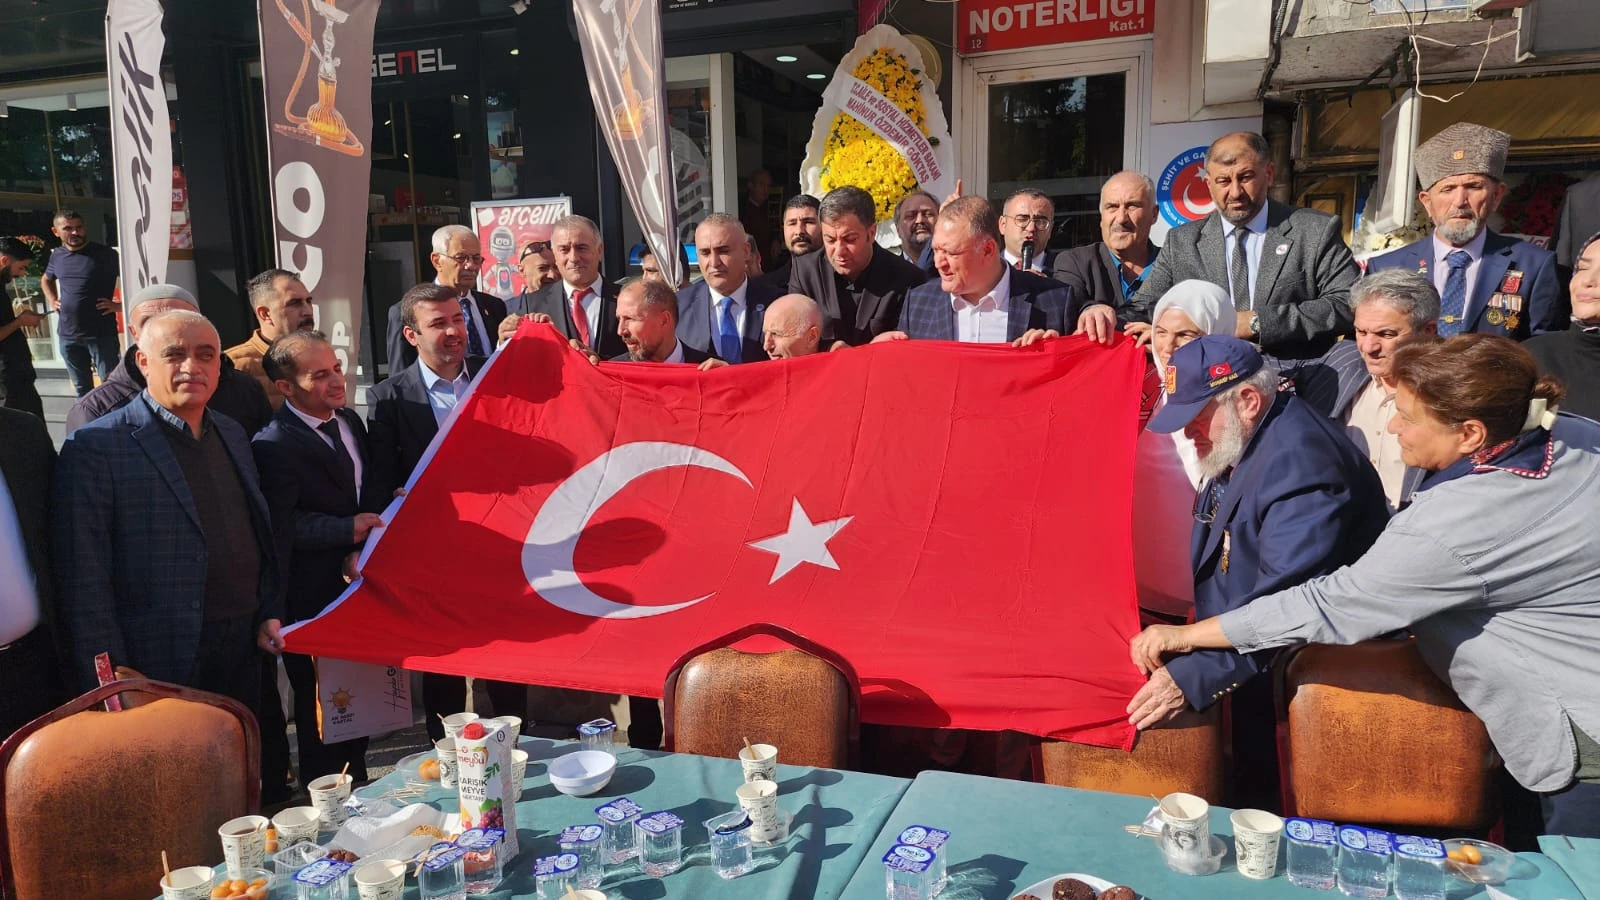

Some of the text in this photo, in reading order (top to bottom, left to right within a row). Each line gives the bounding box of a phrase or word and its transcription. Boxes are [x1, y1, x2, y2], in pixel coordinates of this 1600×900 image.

[1109, 18, 1145, 33] Kat.1
[971, 39, 982, 49] 12
[875, 99, 901, 123] SOSYAL
[896, 117, 929, 155] HİZMETLER
[874, 115, 909, 148] ÖZDEMİR
[906, 146, 930, 184] GÖKTAŞ
[1177, 156, 1191, 166] VE
[1192, 152, 1206, 160] GA
[498, 204, 566, 230] arçelik
